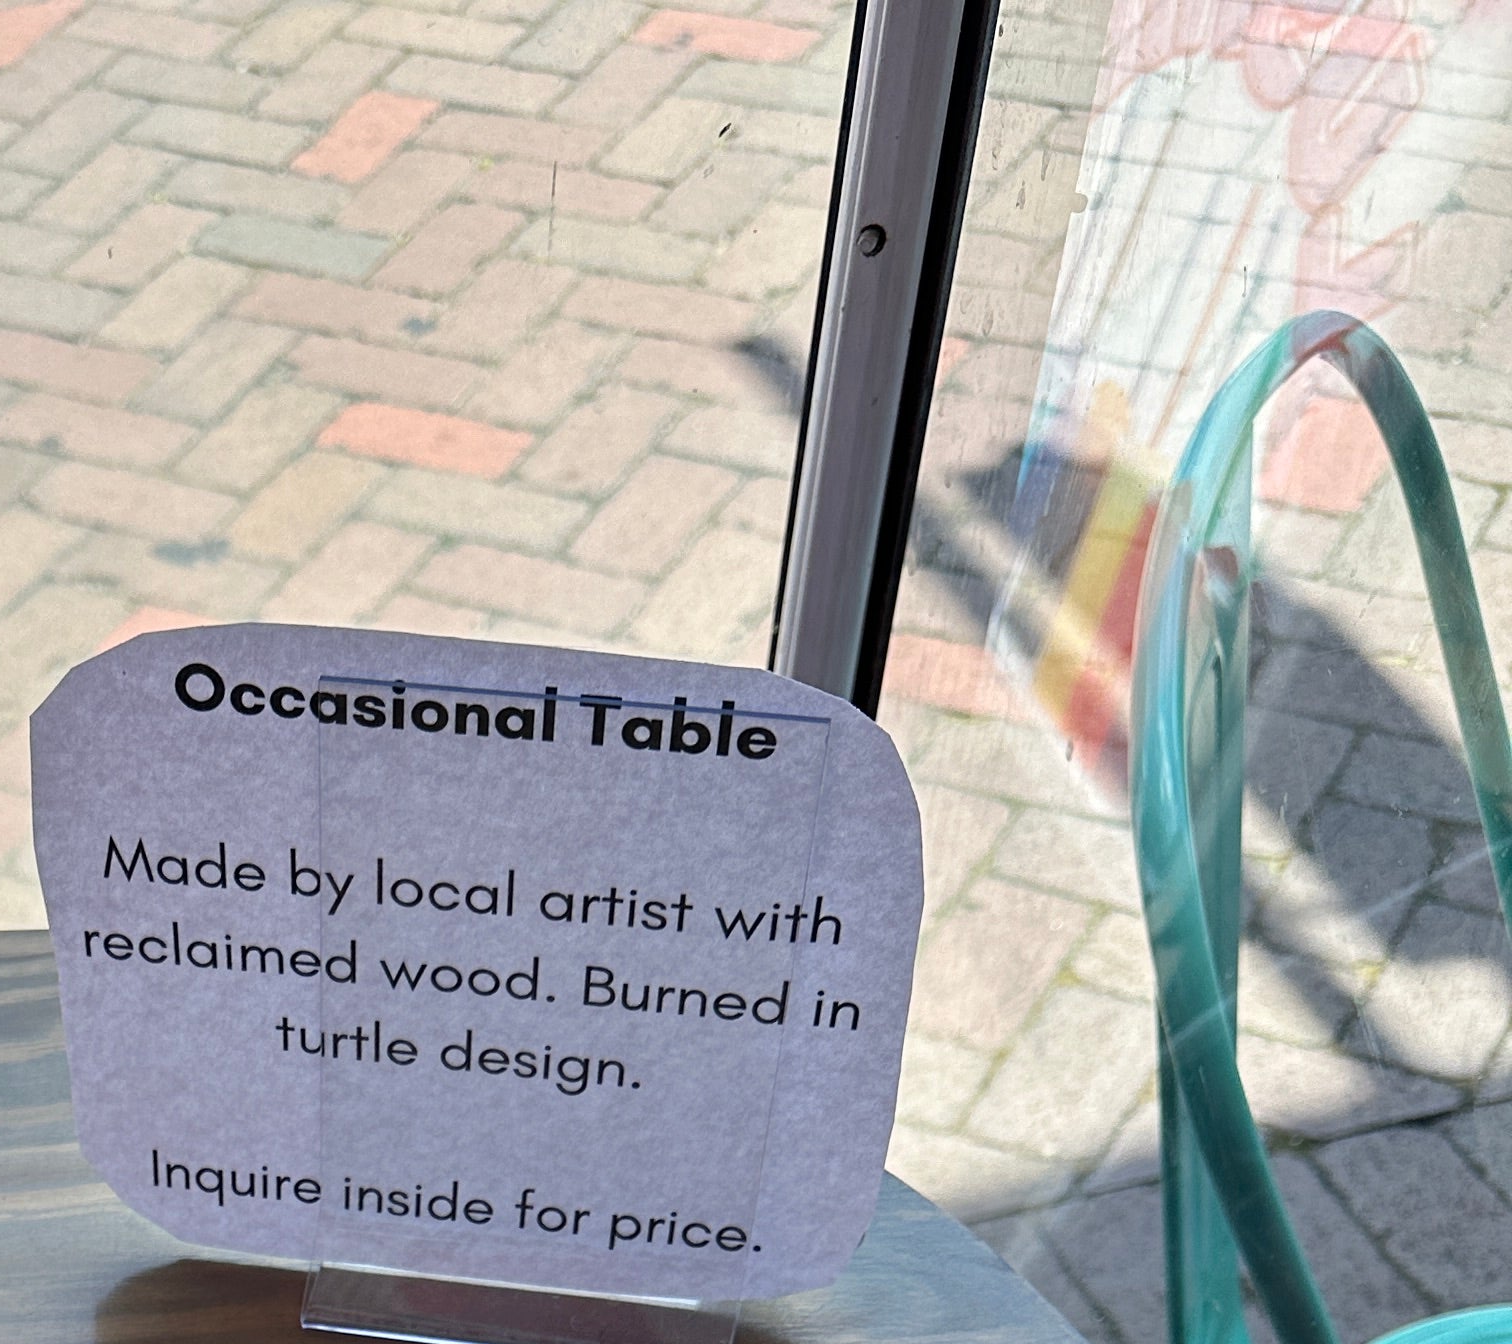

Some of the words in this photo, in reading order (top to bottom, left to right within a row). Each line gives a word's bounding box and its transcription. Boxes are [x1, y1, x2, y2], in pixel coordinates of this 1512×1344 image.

[174, 662, 557, 742] Occasional
[578, 694, 779, 760] Table
[103, 835, 266, 892] Made
[290, 848, 355, 916] by
[376, 857, 515, 917] local
[539, 887, 694, 933] artist
[714, 895, 842, 945] with
[84, 923, 357, 984] reclaimed
[379, 956, 555, 1003] wood.
[583, 965, 790, 1025] Burned
[813, 990, 860, 1031] in
[275, 1017, 418, 1066] turtle
[440, 1029, 641, 1096] design.
[152, 1149, 321, 1207] Inquire
[344, 1177, 494, 1225] inside
[514, 1188, 591, 1235] for
[608, 1211, 762, 1253] price.
